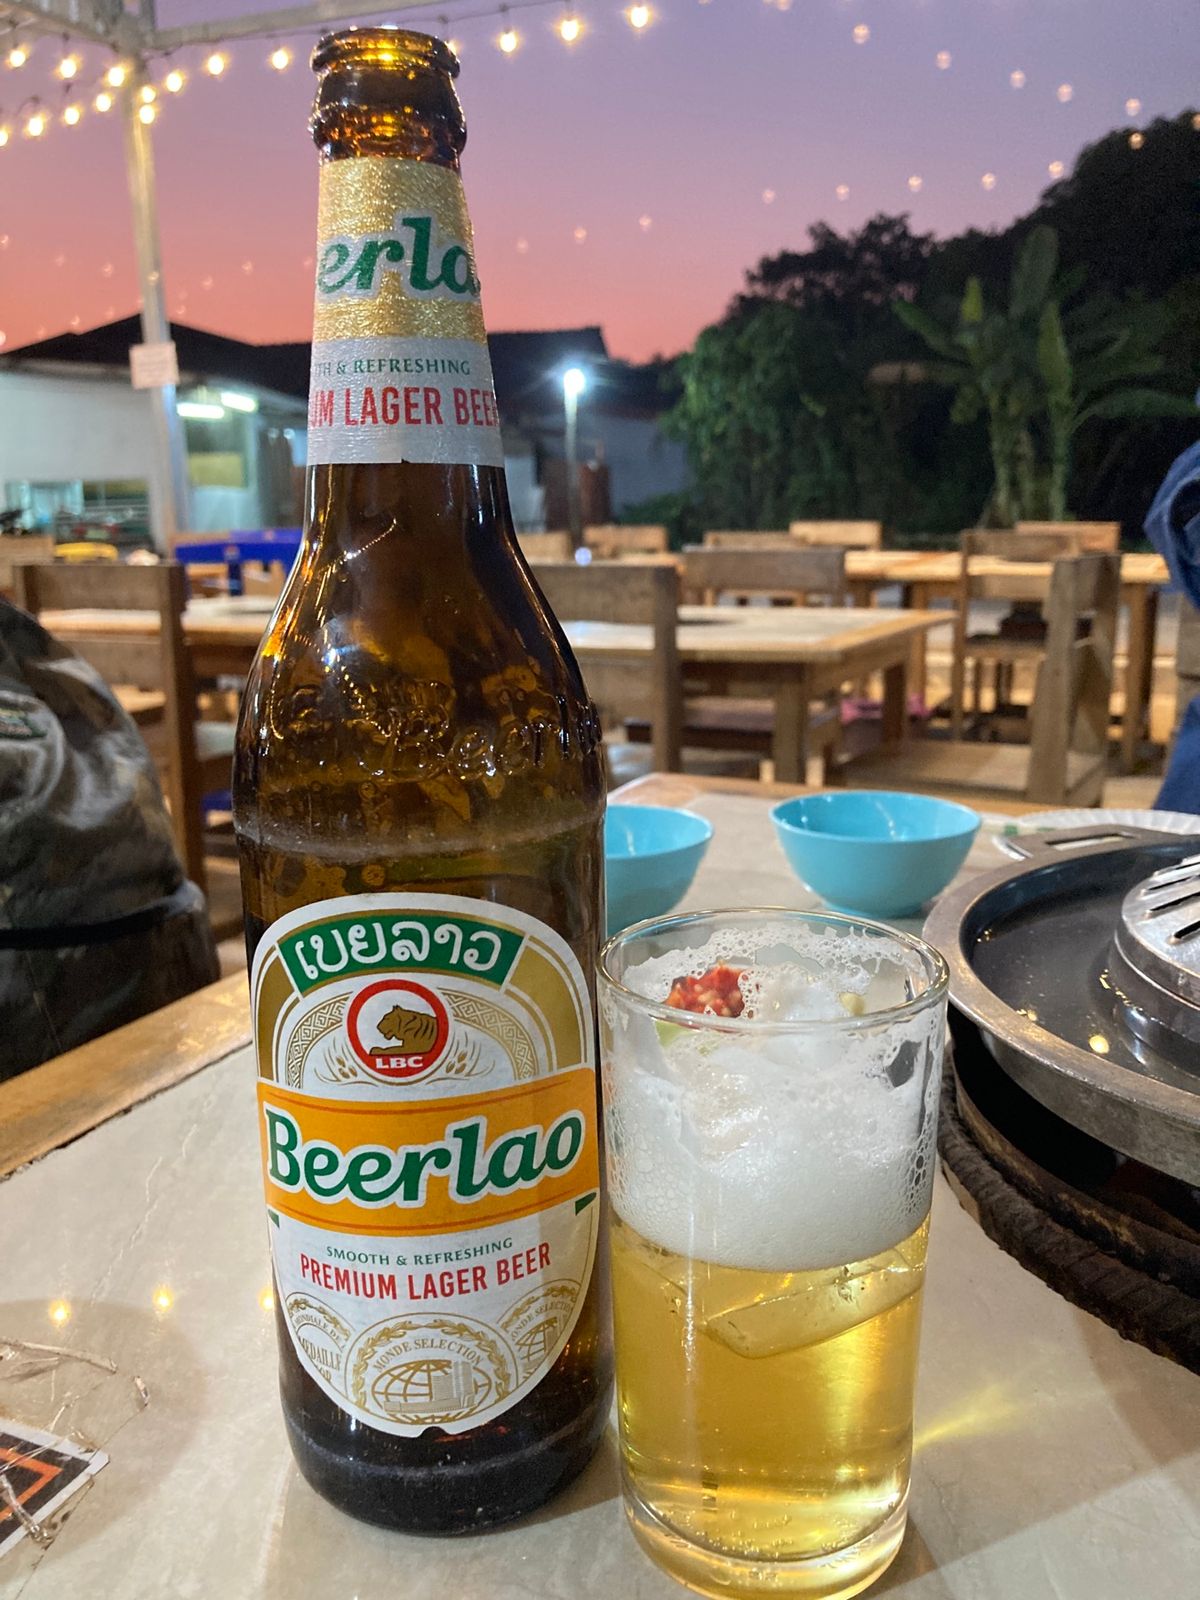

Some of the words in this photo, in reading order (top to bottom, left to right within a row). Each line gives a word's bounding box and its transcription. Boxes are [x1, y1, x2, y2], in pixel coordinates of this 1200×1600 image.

[336, 361, 347, 374] &
[354, 358, 471, 375] REFRESHING
[345, 387, 443, 426] LAGER
[295, 921, 502, 980] ເບຍລາວ
[376, 1056, 423, 1069] LBC
[265, 1108, 584, 1203] Beerlao
[326, 1246, 390, 1266] SMOOTH
[396, 1255, 408, 1266] &
[413, 1238, 513, 1266] REFRESHING
[300, 1253, 397, 1300] PREMIUM
[407, 1265, 488, 1300] LAGER
[496, 1242, 551, 1286] BEER
[373, 1341, 412, 1371] MONDE
[414, 1338, 483, 1366] SELECTION
